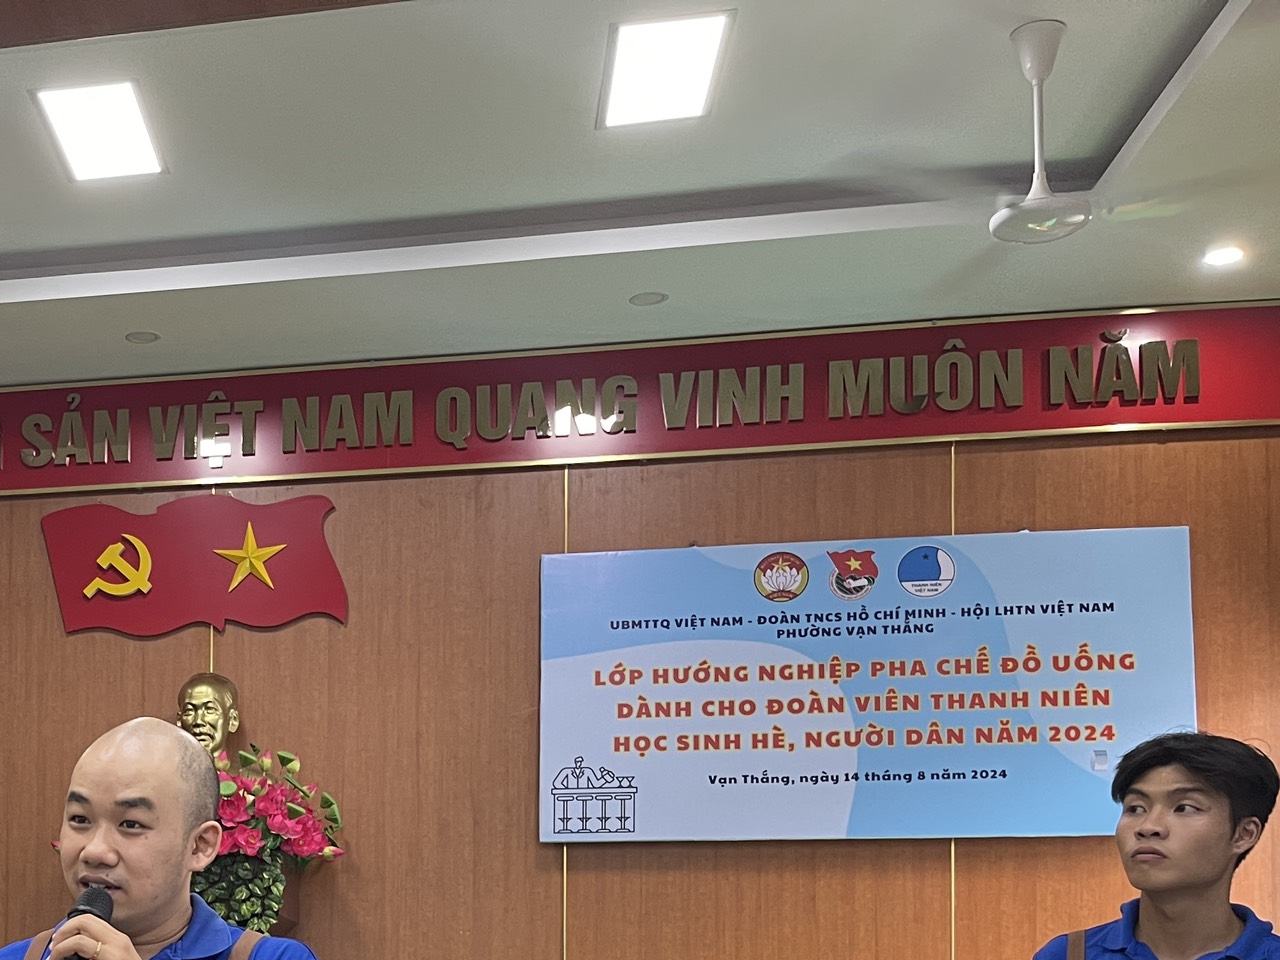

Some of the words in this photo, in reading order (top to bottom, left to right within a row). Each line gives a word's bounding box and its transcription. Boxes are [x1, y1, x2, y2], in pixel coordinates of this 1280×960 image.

[21, 393, 131, 468] SẢN
[149, 391, 264, 468] VIỆT
[282, 390, 413, 453] NAM
[435, 375, 638, 450] QUANG
[659, 363, 804, 430] VINH
[828, 338, 1023, 419] MUÔN
[1045, 328, 1200, 407] NĂM
[610, 618, 671, 630] UBMTTQ
[675, 614, 706, 630] VIỆT
[710, 616, 743, 627] NAM
[757, 611, 800, 625] ĐOÀN
[805, 612, 842, 624] TNCS
[847, 605, 869, 621] HỒ
[874, 606, 900, 620] CHÍ
[904, 608, 946, 621] MINH
[961, 603, 990, 619] HỘI
[995, 605, 1036, 616] LHTN
[1040, 600, 1074, 616] VIỆT
[1079, 602, 1115, 613] NAM
[776, 624, 842, 639] PHƯỜNG
[845, 625, 877, 639] VẠN
[882, 620, 935, 635] THẮNG
[594, 662, 643, 686] LỚP
[652, 659, 749, 684] HƯỚNG
[758, 656, 861, 685] NGHIỆP
[870, 660, 927, 678] PHA
[936, 646, 990, 675] CHẾ
[1000, 644, 1041, 673] ĐỒ
[1052, 643, 1135, 672] UỐNG
[617, 695, 692, 719] DÀNH
[701, 699, 756, 717] CHO
[765, 690, 845, 715] ĐOÀN
[854, 688, 920, 712] VIÊN
[930, 691, 1029, 711] THANH
[1040, 683, 1110, 708] NIÊN
[614, 735, 668, 757] HỌC
[676, 733, 741, 751] SINH
[752, 725, 795, 752] HÈ,
[805, 722, 895, 748] NGƯỜI
[905, 721, 964, 746] DÂN
[975, 719, 1038, 744] NĂM
[1048, 724, 1116, 742] 2024
[708, 774, 737, 787] Vạn
[741, 769, 795, 785] Thắng,
[799, 771, 839, 784] ngày
[844, 773, 860, 782] 14
[864, 769, 912, 783] tháng
[917, 770, 926, 781] 8
[930, 769, 967, 781] năm
[970, 769, 1008, 780] 2024
